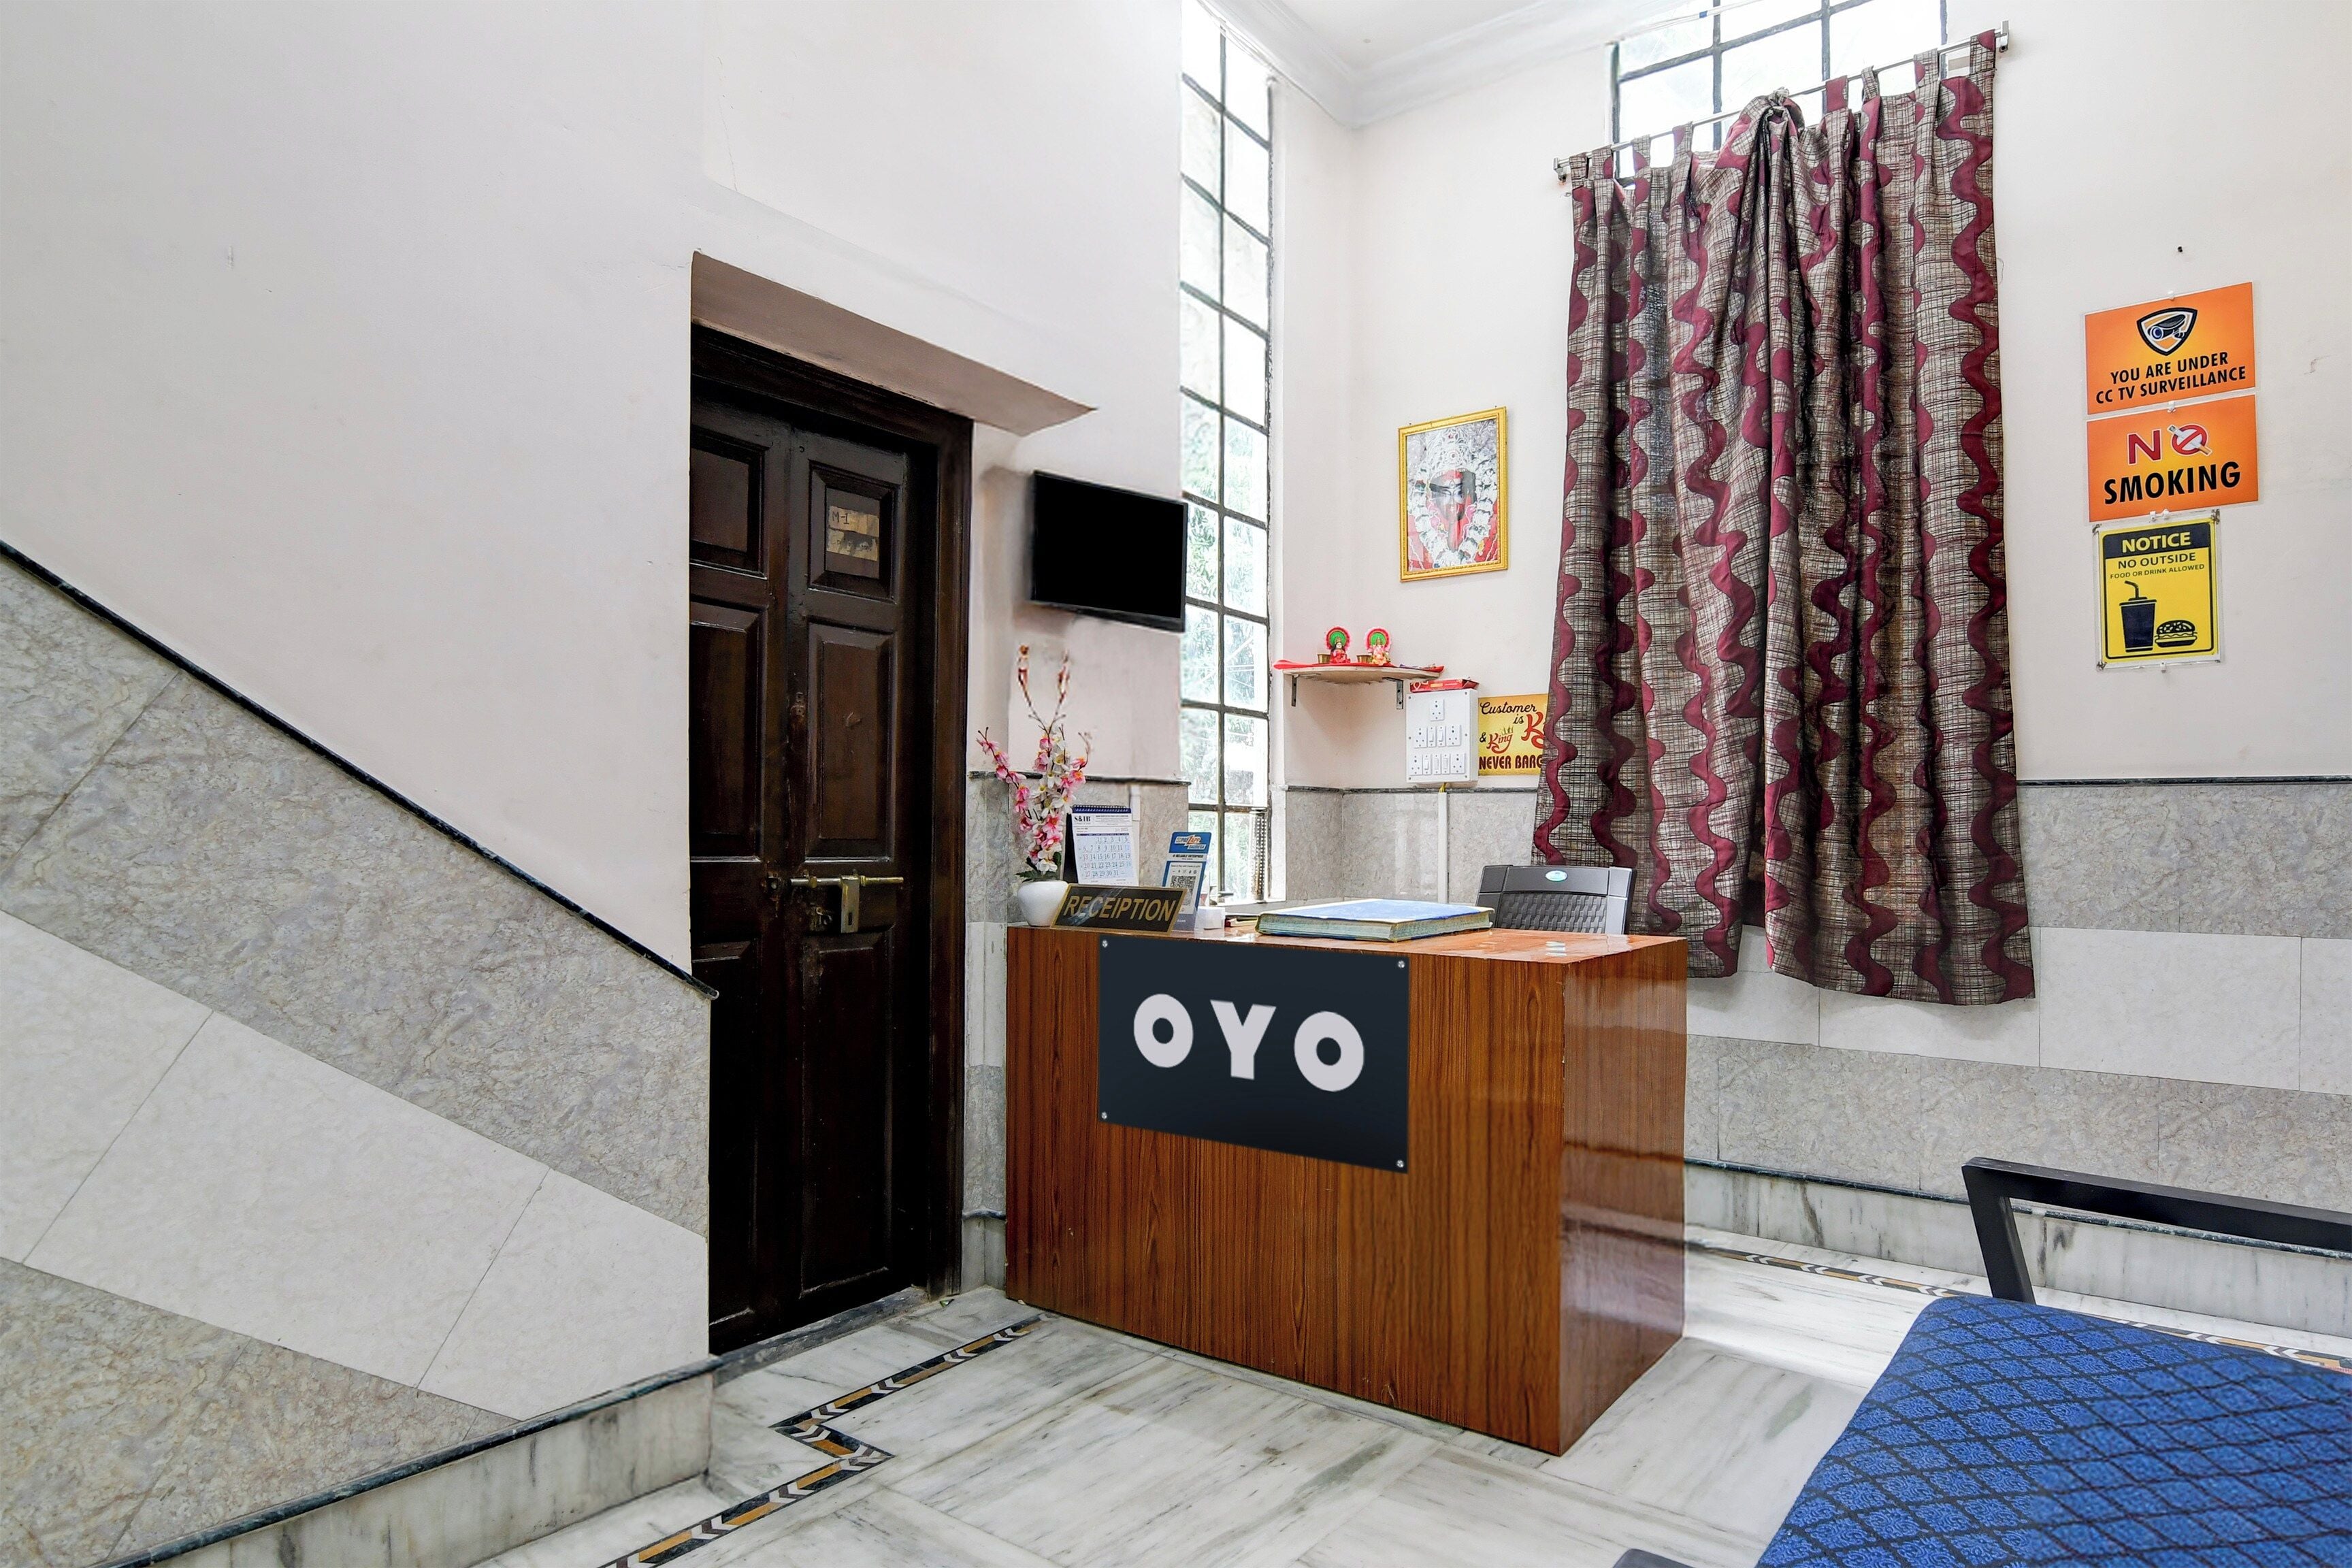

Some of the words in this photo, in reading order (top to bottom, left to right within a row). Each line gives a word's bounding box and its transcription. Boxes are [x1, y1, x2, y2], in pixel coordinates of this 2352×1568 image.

[2110, 367, 2140, 385] YOU
[2145, 361, 2172, 379] ARE
[2177, 351, 2229, 372] UNDER
[2095, 389, 2113, 404] CC
[2118, 386, 2136, 402] TV
[2140, 365, 2247, 397] SURVEILLANCE
[2104, 461, 2241, 505] SMOKING
[2121, 532, 2191, 553] NOTICE
[2118, 559, 2137, 570] NO
[2140, 552, 2196, 567] OUTSIDE
[2110, 572, 2131, 580] FOOD
[2144, 567, 2167, 576] DRINK
[2168, 564, 2205, 573] ALLOWED
[1480, 701, 1537, 715] Customer
[1512, 713, 1524, 724] is
[1479, 732, 1486, 743] &
[1486, 732, 1514, 754] King
[1479, 755, 1512, 770] NEVER
[1515, 754, 1544, 769] BARG
[1063, 896, 1177, 921] RECEIPTION
[1133, 993, 1365, 1092] OYO
